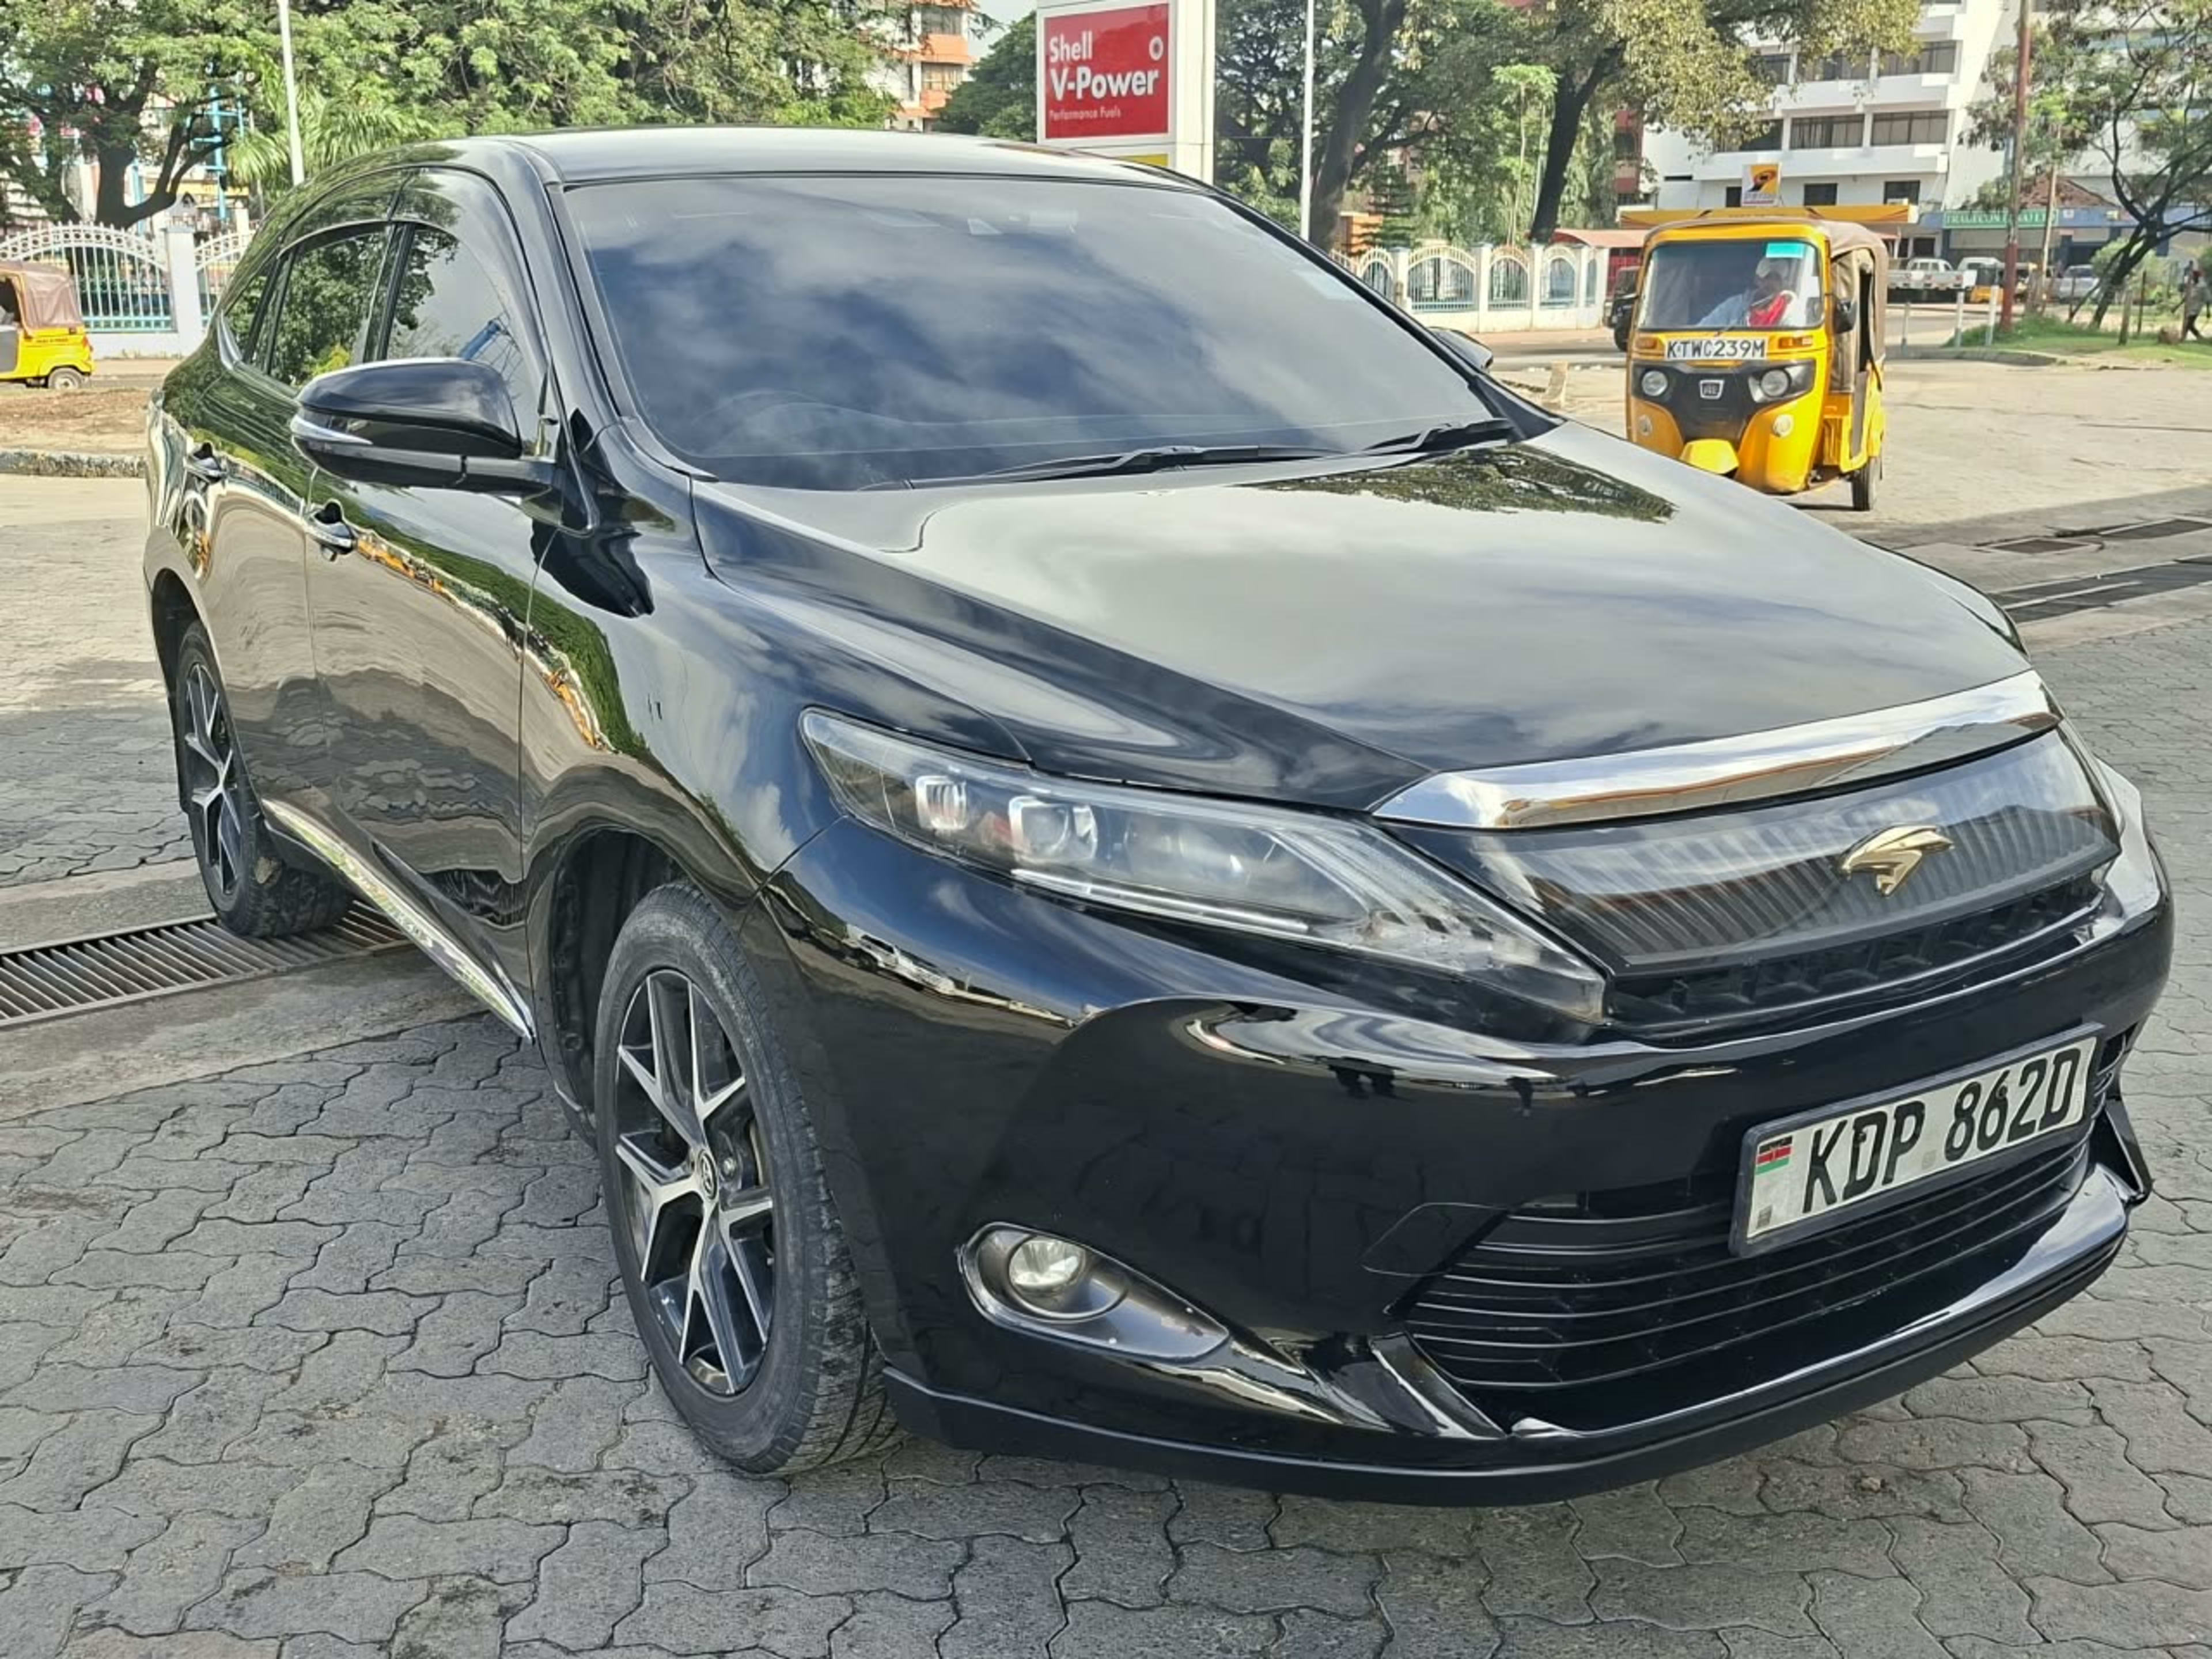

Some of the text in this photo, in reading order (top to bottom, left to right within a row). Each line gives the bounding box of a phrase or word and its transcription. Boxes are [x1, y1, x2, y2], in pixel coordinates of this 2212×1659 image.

[1049, 31, 1093, 63] Shell
[1050, 66, 1159, 101] V-Power
[1048, 105, 1120, 121] Performance Fuels
[1802, 1047, 2081, 1213] KDP 862D
